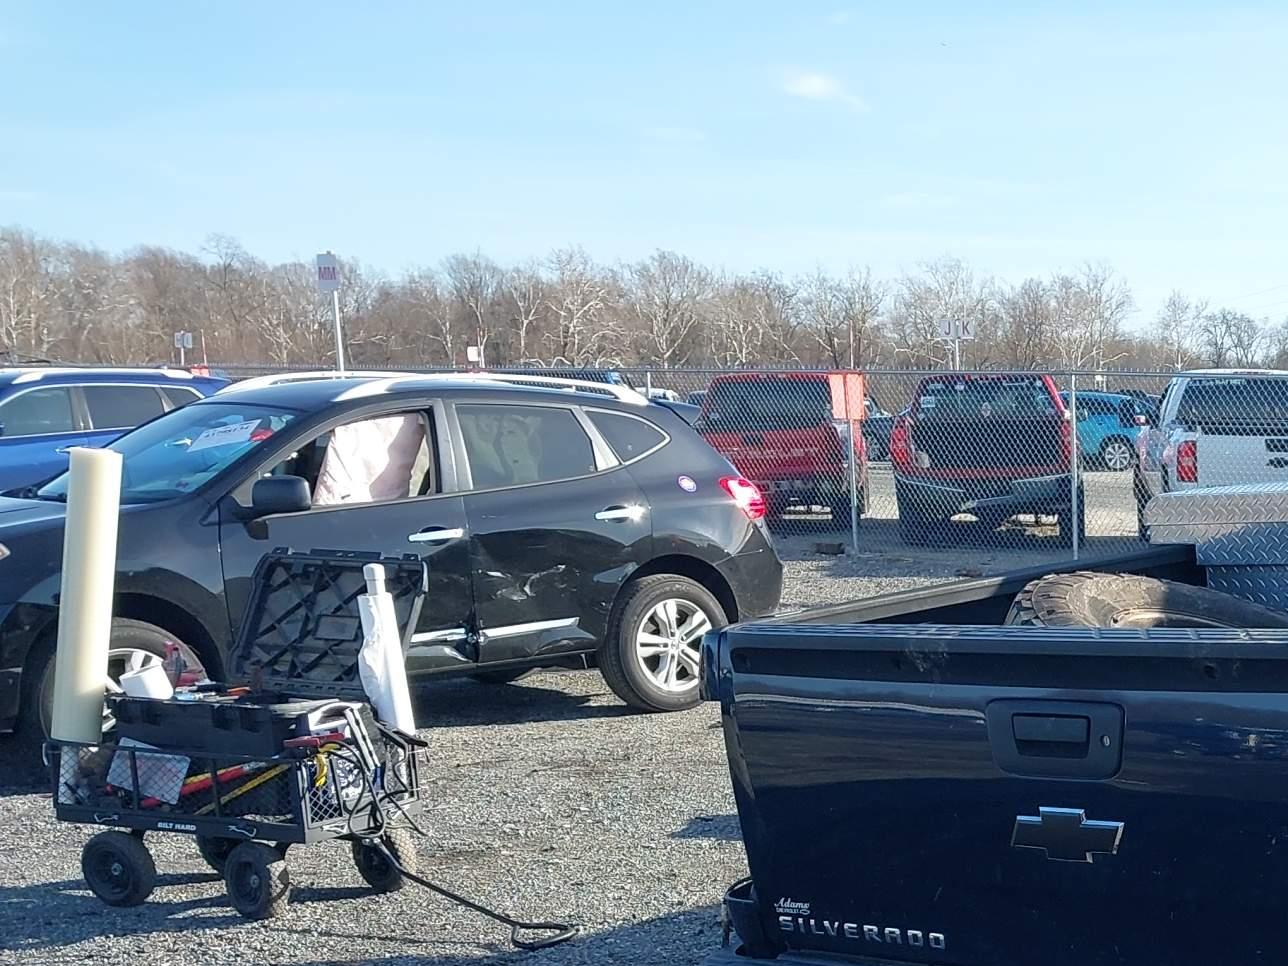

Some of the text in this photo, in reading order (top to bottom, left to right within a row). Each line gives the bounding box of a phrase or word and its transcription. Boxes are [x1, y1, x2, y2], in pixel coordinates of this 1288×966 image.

[944, 320, 951, 336] J
[962, 320, 971, 335] K
[174, 823, 197, 831] HARD
[773, 897, 810, 909] Adams
[778, 915, 946, 950] SILVERADO
